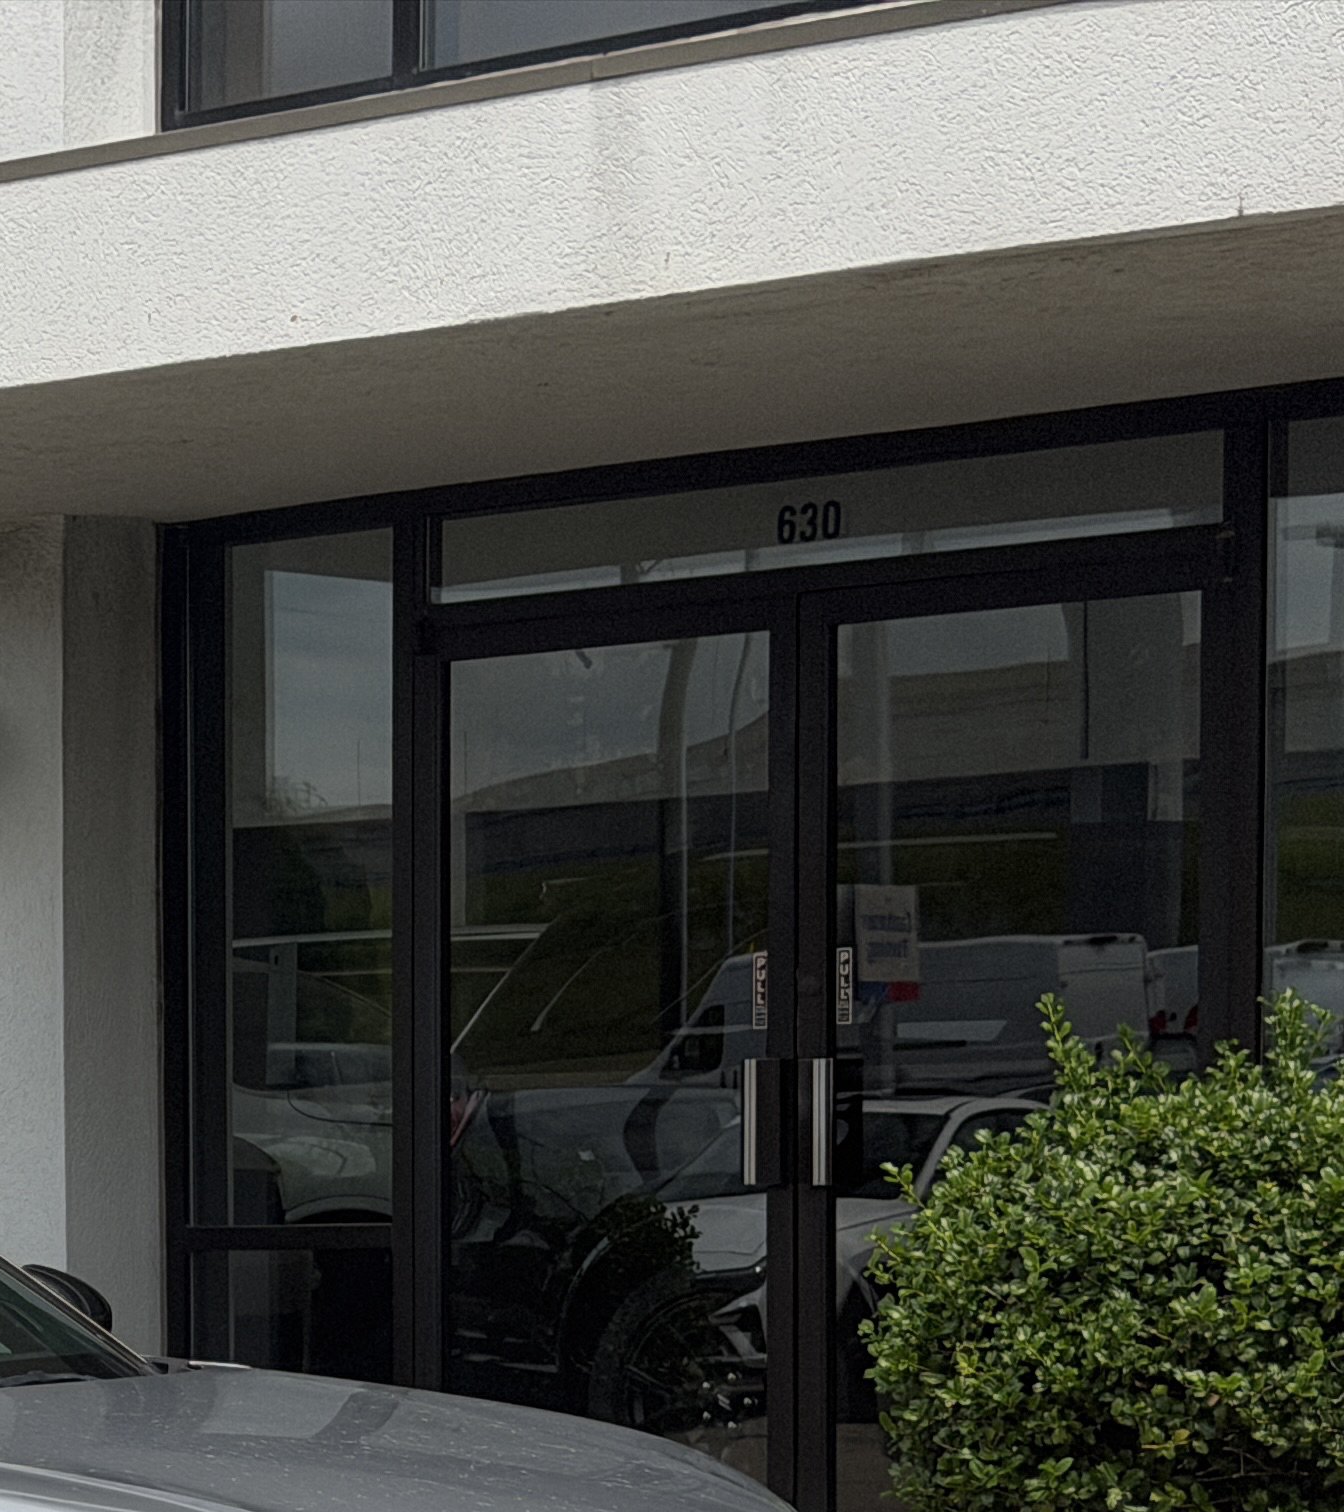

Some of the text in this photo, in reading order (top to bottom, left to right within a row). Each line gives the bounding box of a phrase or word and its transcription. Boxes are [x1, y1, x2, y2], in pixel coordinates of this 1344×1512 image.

[777, 500, 841, 544] 630
[756, 957, 766, 1004] PULL
[839, 951, 849, 999] PULL
